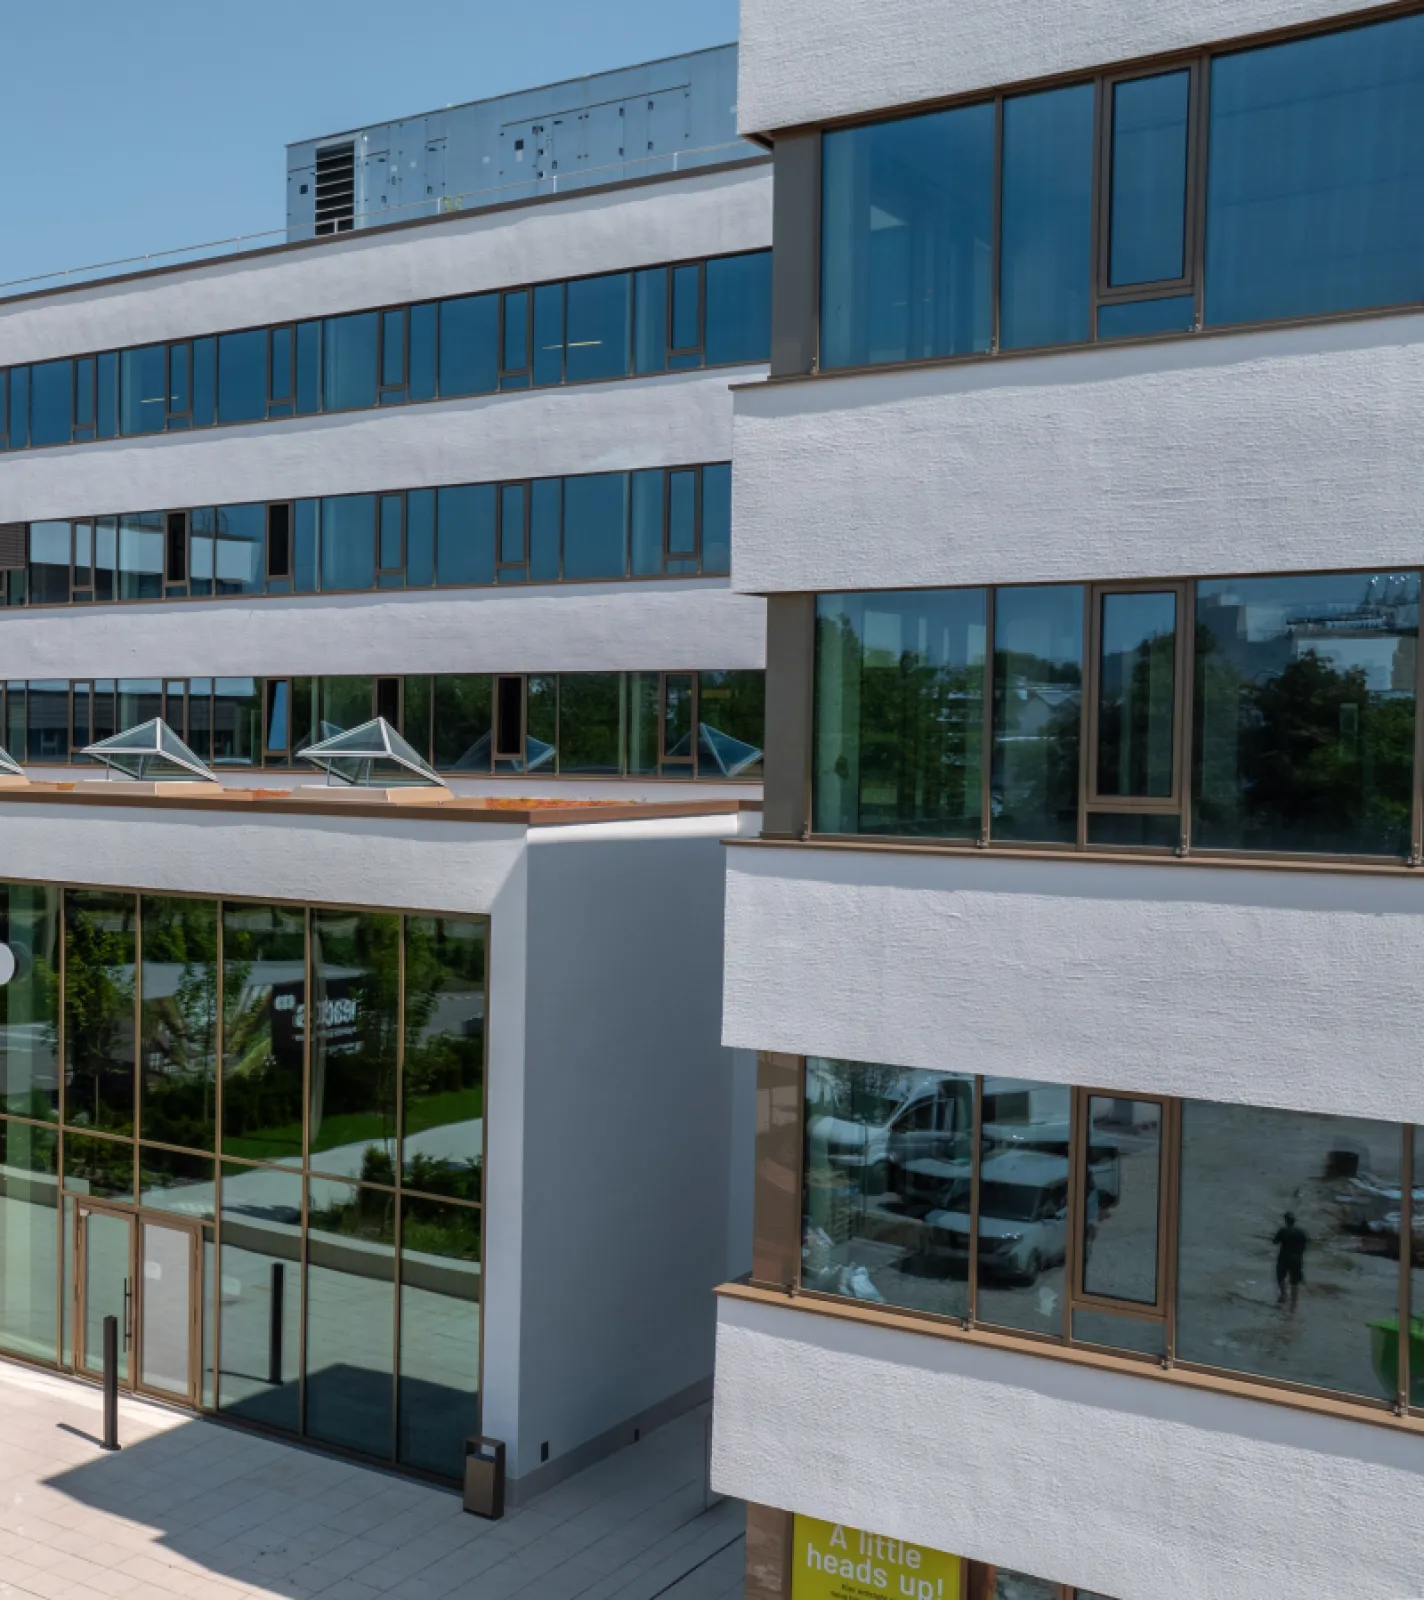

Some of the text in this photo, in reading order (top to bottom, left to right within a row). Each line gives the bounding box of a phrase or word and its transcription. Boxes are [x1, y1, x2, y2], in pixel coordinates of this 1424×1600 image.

[806, 1542, 888, 1588] heads
[829, 1523, 921, 1569] A little
